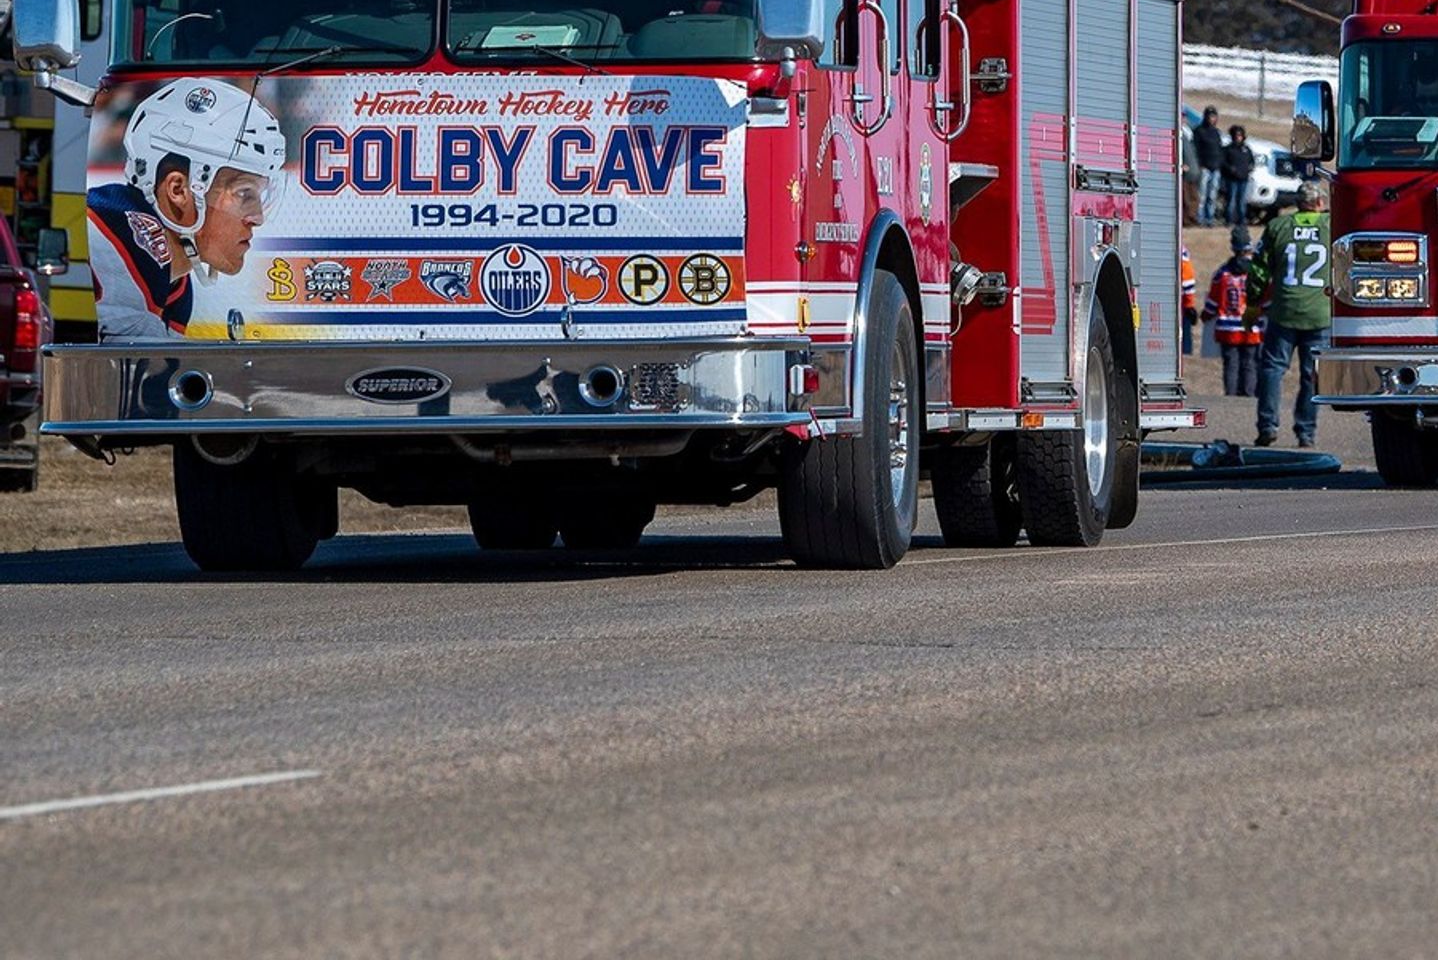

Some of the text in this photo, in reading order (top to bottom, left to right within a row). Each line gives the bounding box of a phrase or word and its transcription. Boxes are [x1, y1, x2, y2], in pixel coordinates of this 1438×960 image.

[354, 90, 672, 121] Hometown Hockey Hero
[301, 125, 728, 195] COLBY CAVE
[410, 204, 618, 227] 1994-2020
[1294, 227, 1320, 241] CAVE
[1283, 242, 1328, 287] 12
[307, 281, 350, 291] STARS
[488, 270, 542, 291] OILERS
[633, 263, 659, 297] P
[693, 264, 716, 293] B
[358, 378, 439, 393] SUPERIOR
